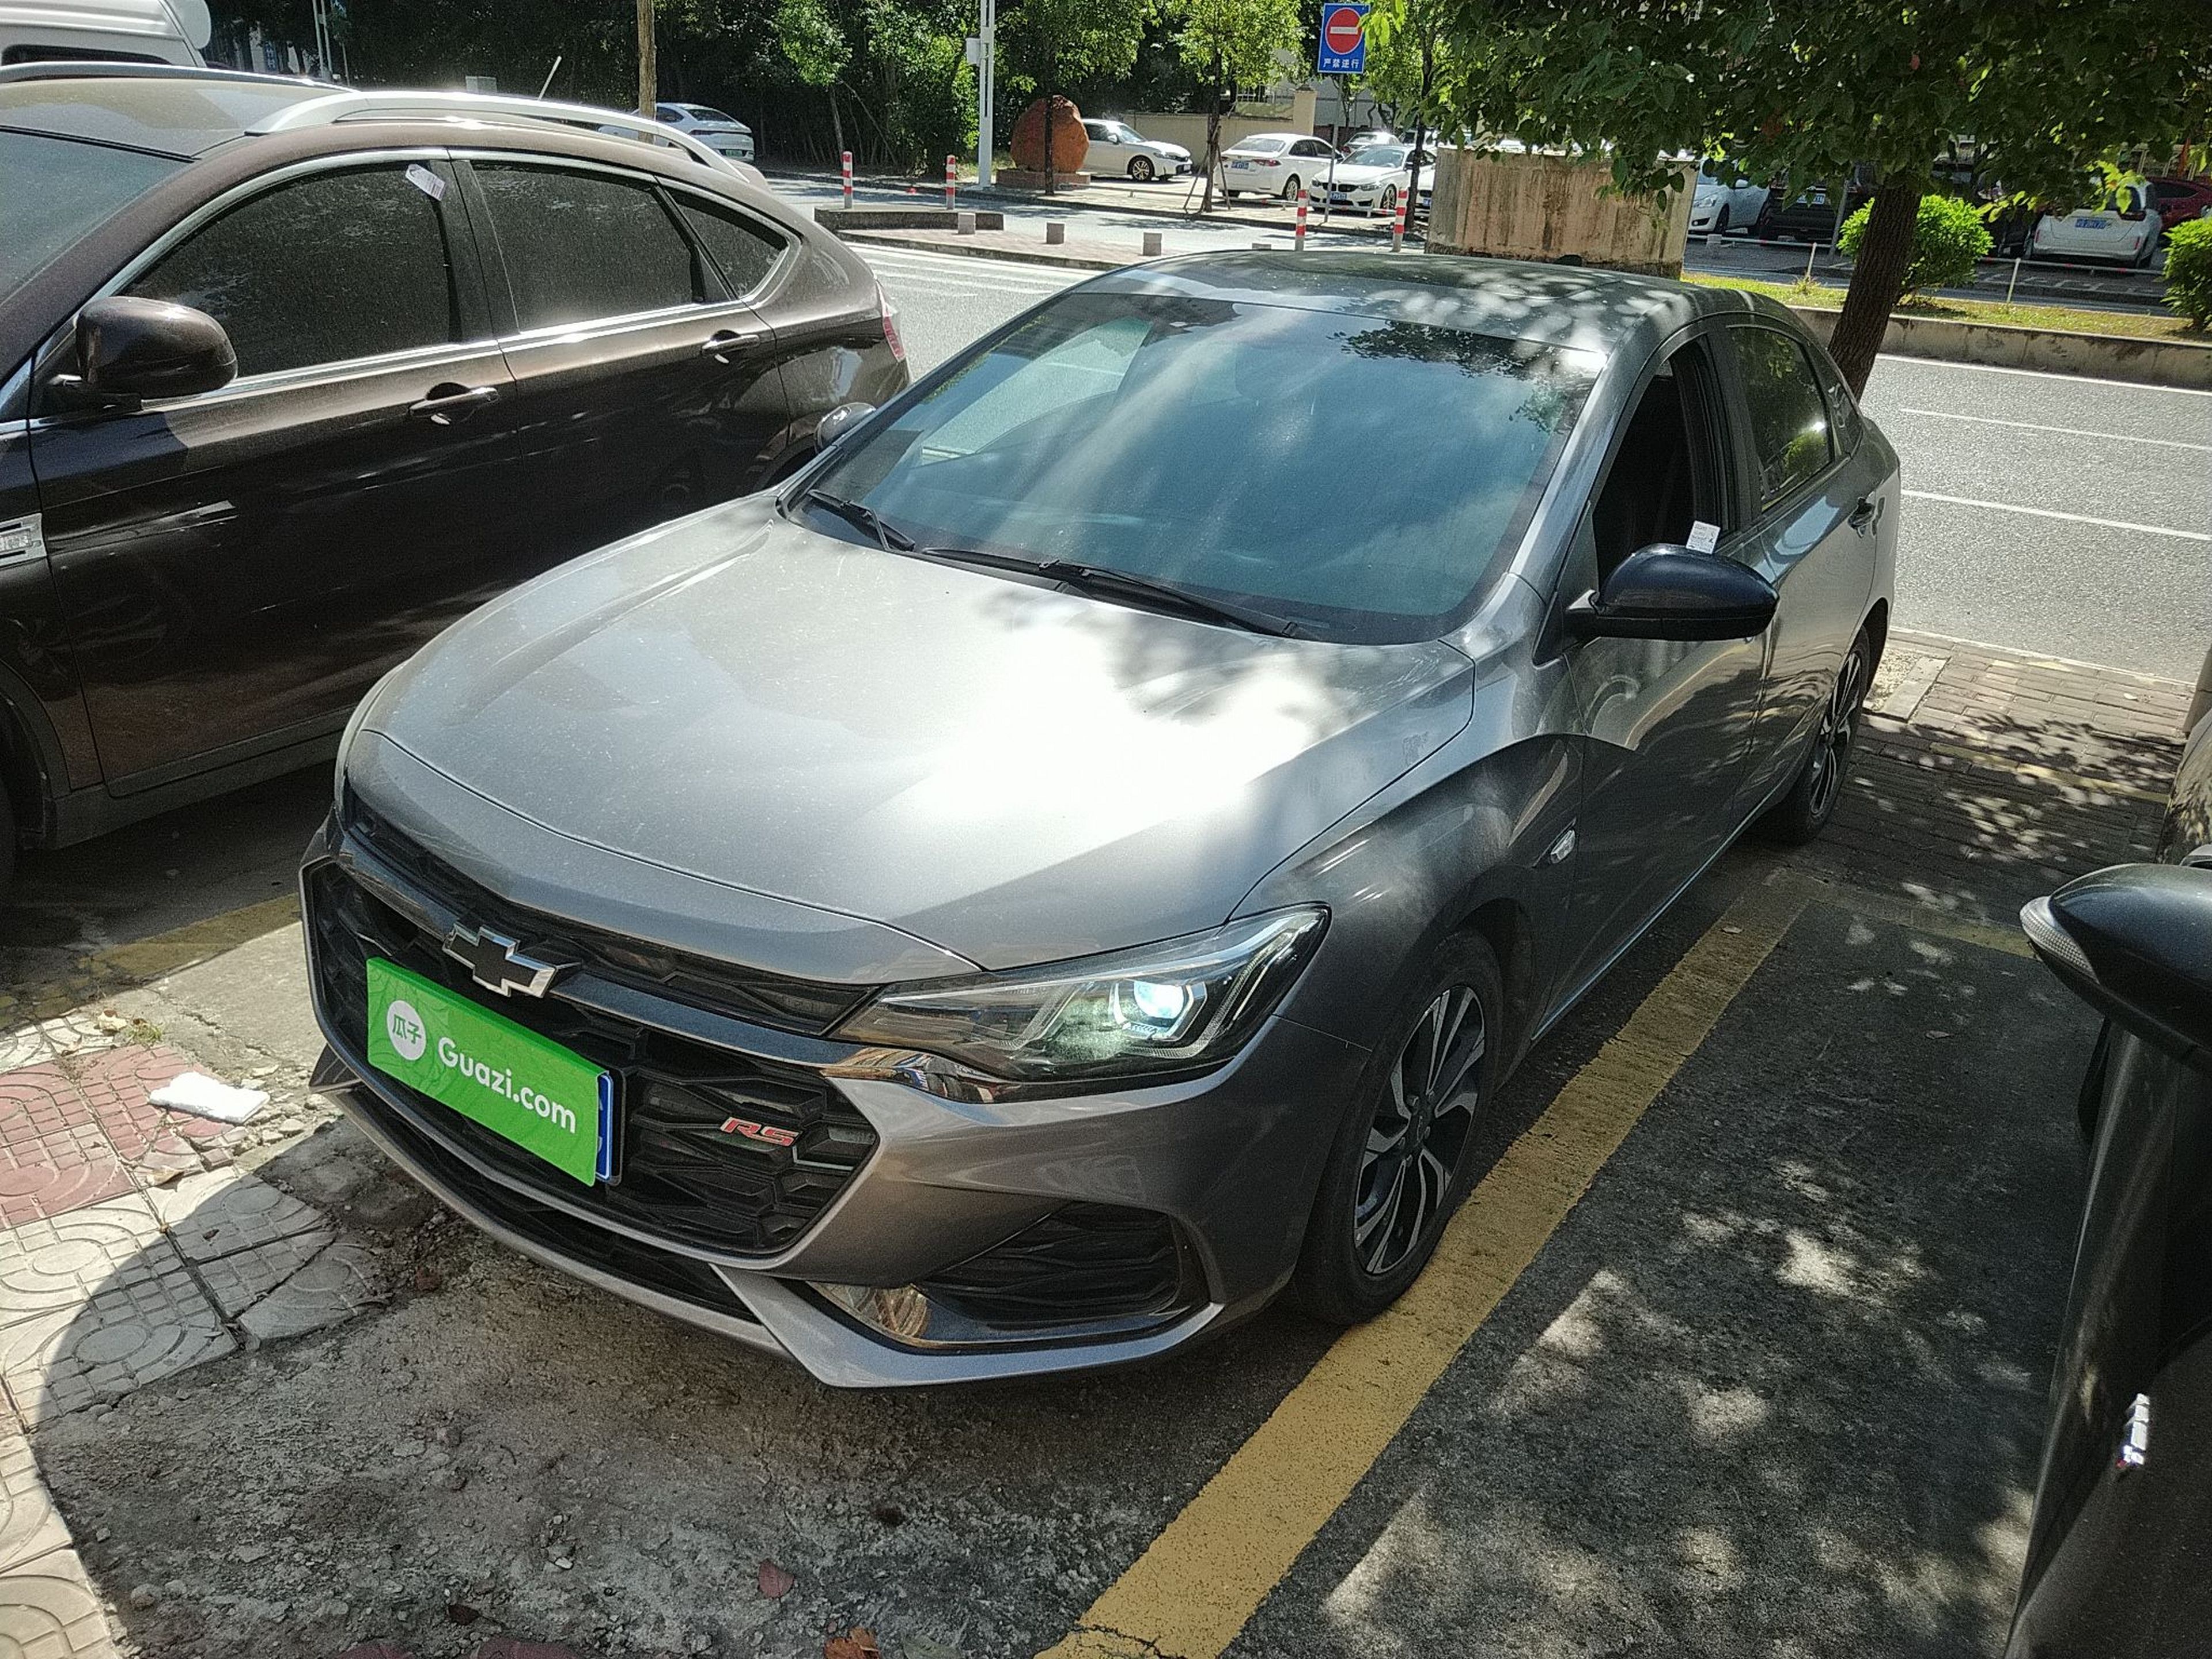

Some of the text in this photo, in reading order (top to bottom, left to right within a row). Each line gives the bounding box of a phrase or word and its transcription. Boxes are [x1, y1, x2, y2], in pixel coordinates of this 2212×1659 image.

[1323, 58, 1359, 69] 严禁逆行
[392, 1014, 422, 1044] 瓜子
[438, 1036, 576, 1134] Guazi.com
[719, 1116, 800, 1147] RS
